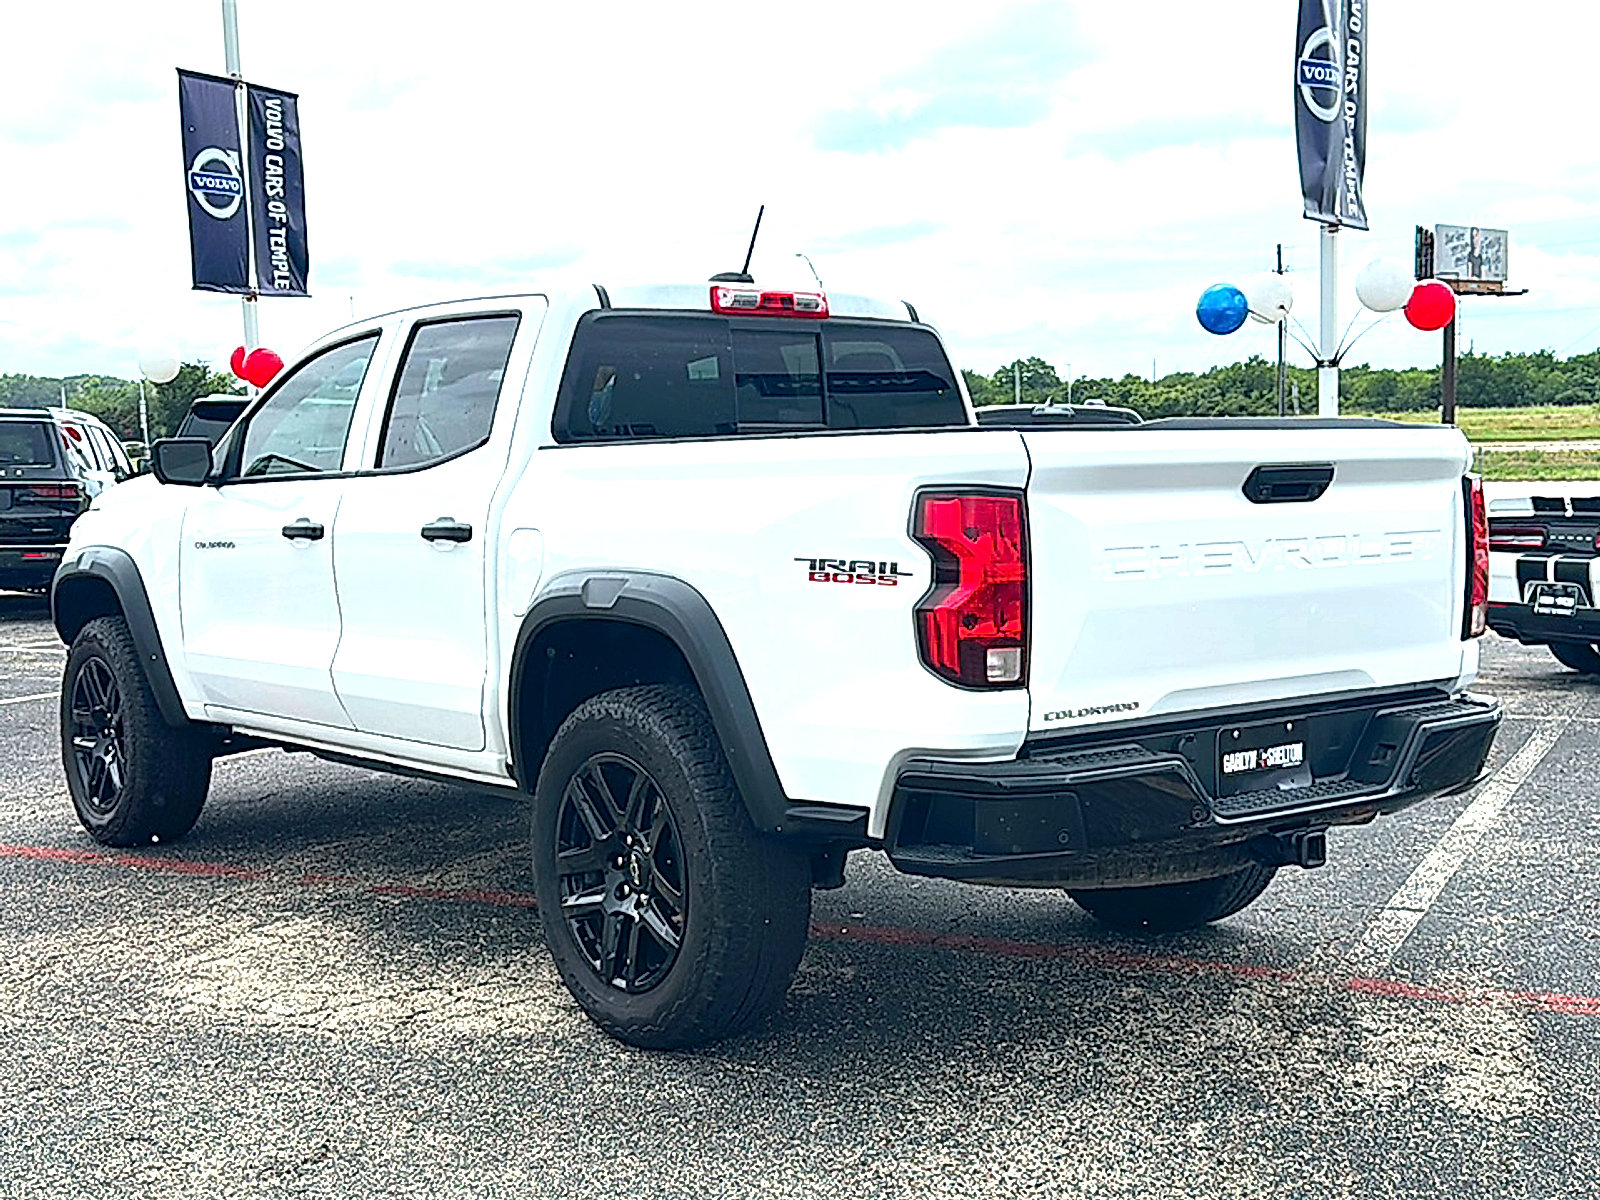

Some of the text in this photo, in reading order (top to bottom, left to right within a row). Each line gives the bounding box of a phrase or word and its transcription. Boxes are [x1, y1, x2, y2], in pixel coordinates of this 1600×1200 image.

[1344, 38, 1361, 95] CARS
[1343, 101, 1358, 133] OF
[193, 175, 240, 191] VOLVO
[264, 98, 291, 291] VOLVO CARS OF TEMPLE
[794, 557, 913, 577] TRAIL
[1100, 529, 1442, 581] CHEVROLET
[808, 571, 898, 586] BOSS
[1043, 701, 1139, 721] COLORADO
